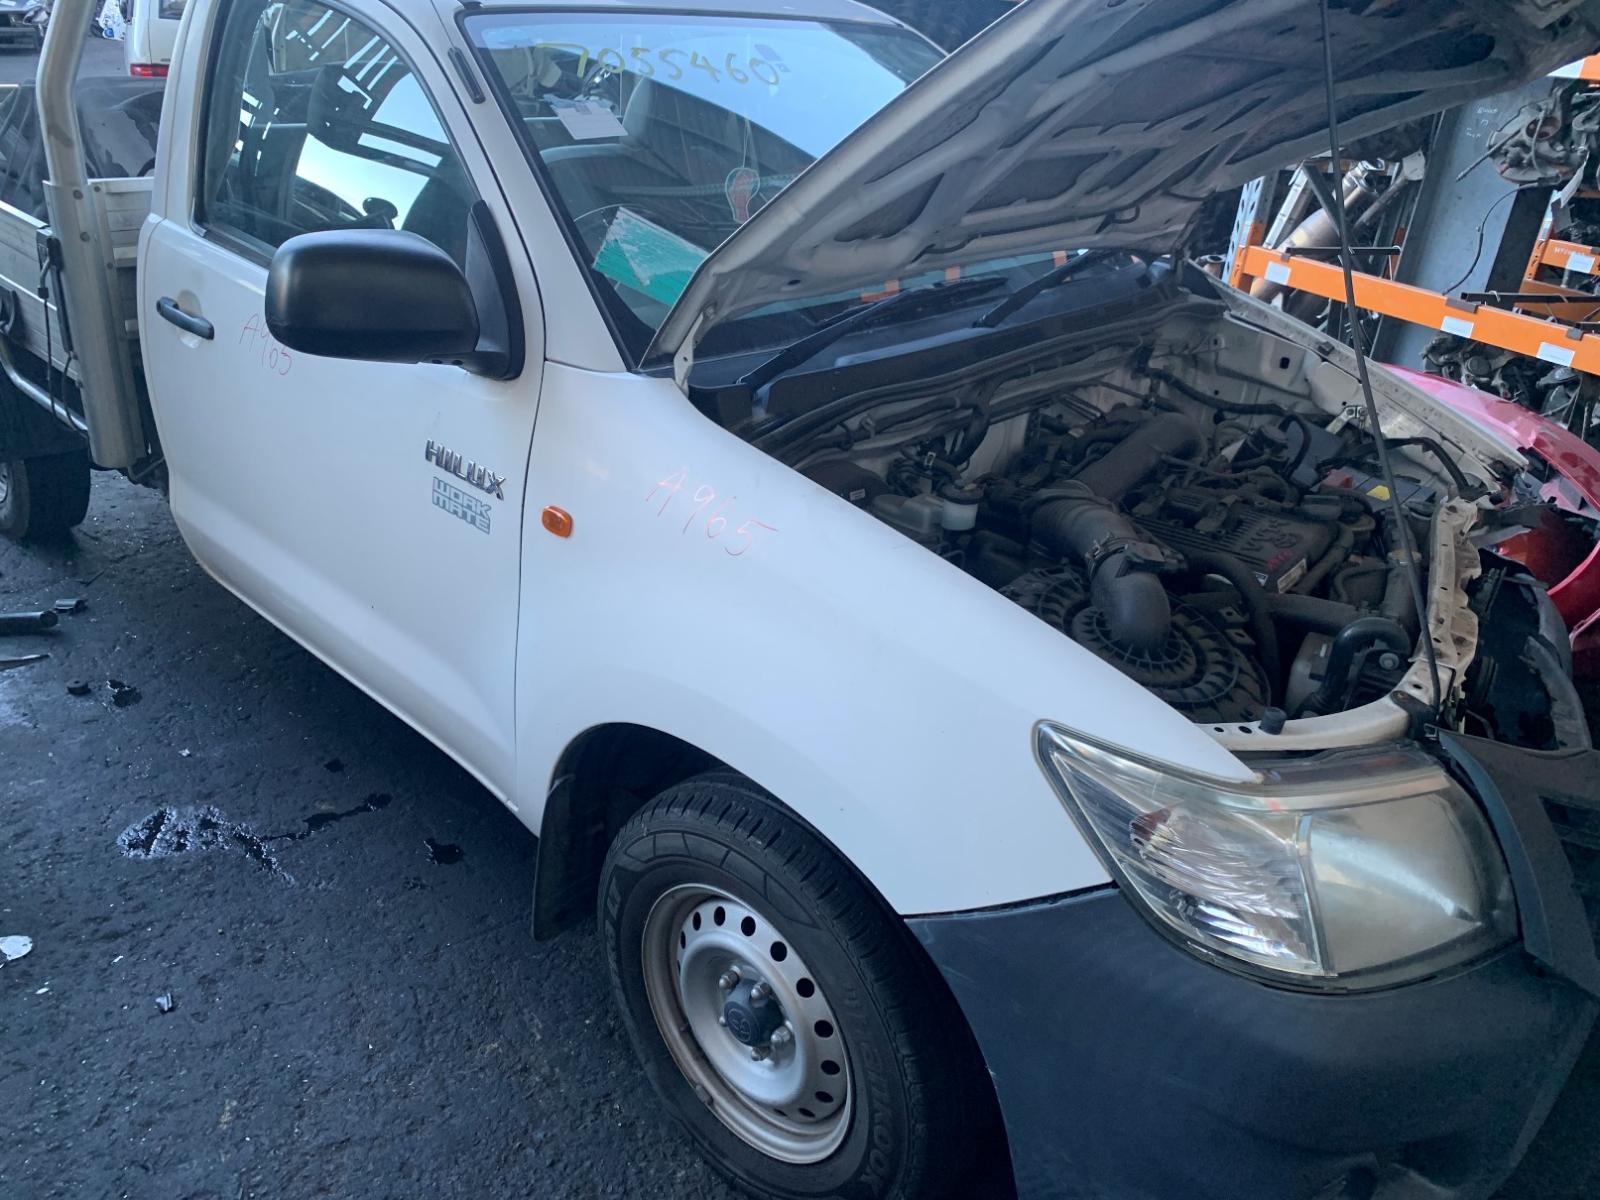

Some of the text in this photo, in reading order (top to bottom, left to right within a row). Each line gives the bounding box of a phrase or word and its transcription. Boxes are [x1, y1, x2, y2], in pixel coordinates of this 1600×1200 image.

[424, 438, 506, 501] HILUX
[431, 475, 492, 520] WORK
[431, 489, 491, 535] MATE
[645, 467, 779, 557] A965
